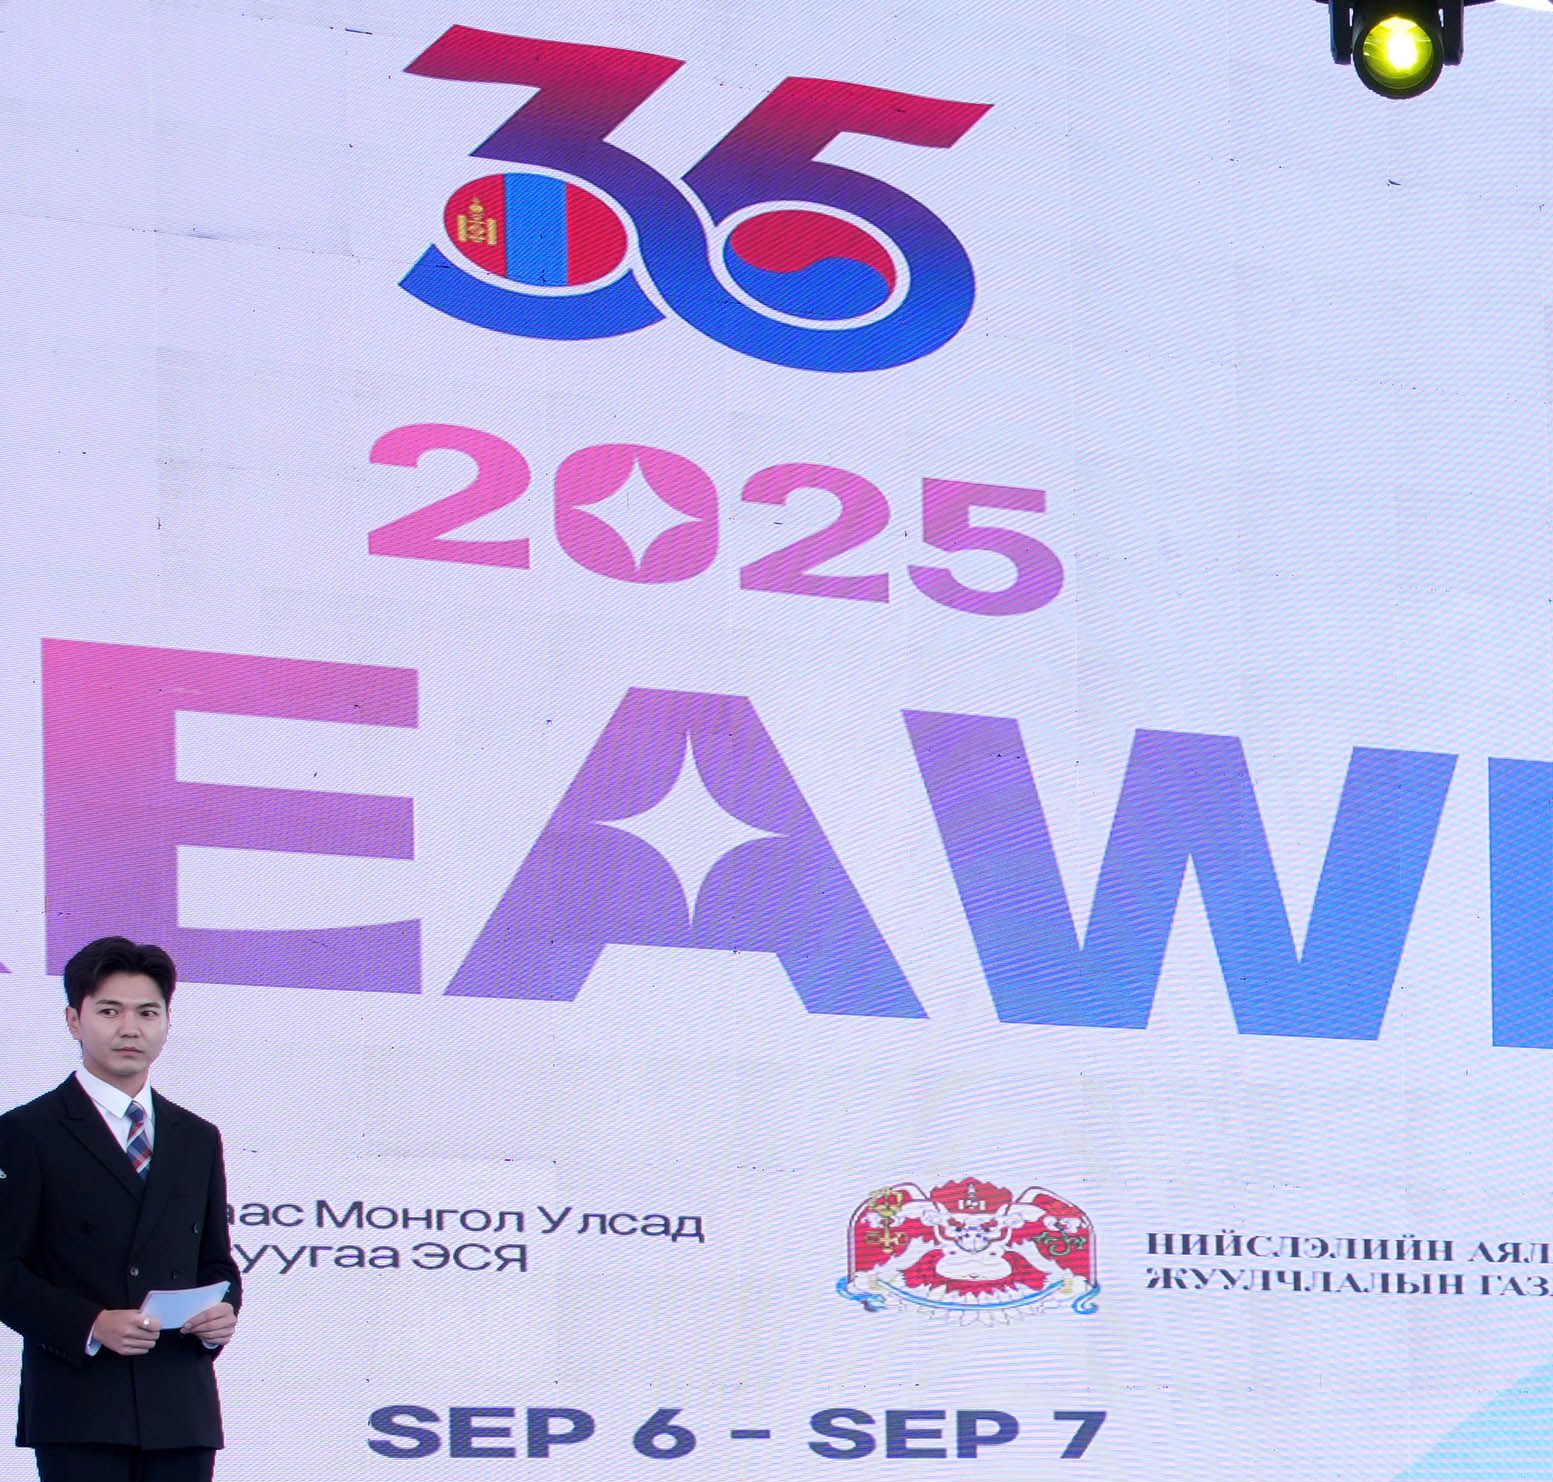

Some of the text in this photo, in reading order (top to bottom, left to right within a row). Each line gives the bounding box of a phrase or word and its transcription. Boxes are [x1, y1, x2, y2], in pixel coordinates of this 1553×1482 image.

[367, 422, 1065, 617] 2025
[316, 1199, 525, 1233] Монгол
[537, 1205, 706, 1243] Улсад
[411, 1241, 528, 1273] ЭСЯ
[1146, 1229, 1455, 1262] НИЙСЛЭЛИЙН
[1146, 1267, 1465, 1296] ЖУУЛЧЛАЛЫН
[367, 1404, 596, 1460] SEP
[632, 1408, 697, 1460] 6
[808, 1408, 1019, 1460] SEP
[1053, 1410, 1107, 1460] 7
